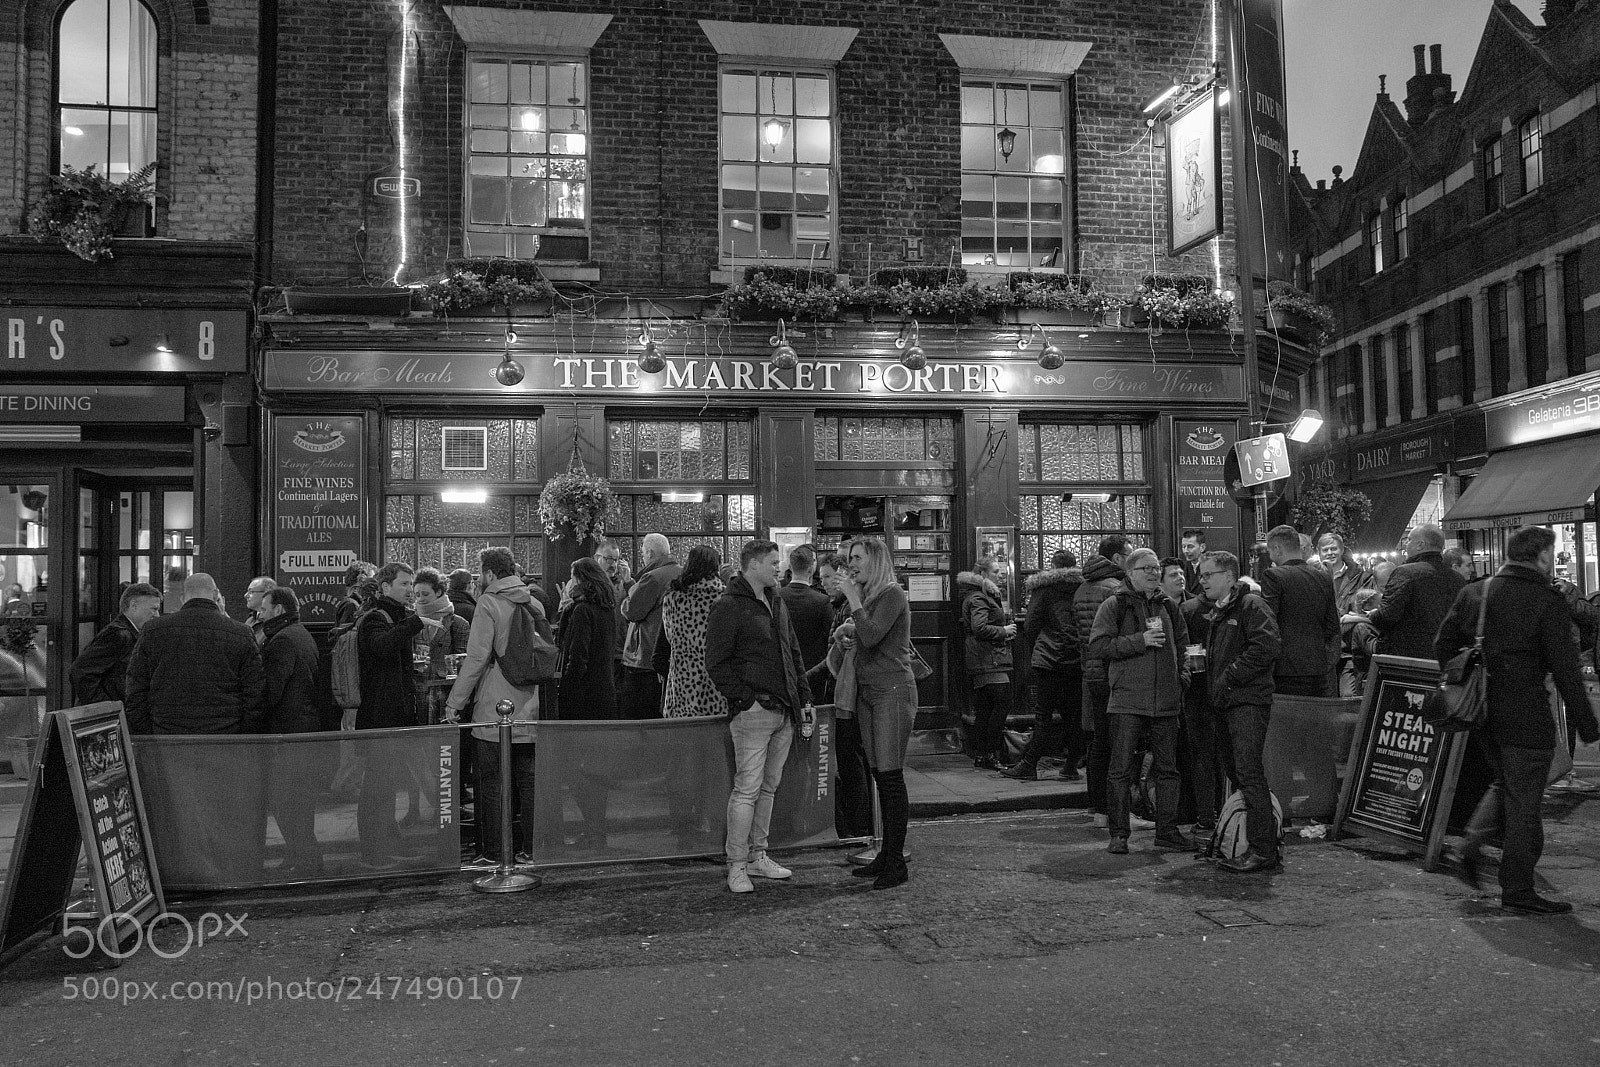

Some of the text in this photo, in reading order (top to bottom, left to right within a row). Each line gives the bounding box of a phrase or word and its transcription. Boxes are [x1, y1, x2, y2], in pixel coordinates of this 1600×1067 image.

[8, 316, 65, 360] R'S
[199, 321, 215, 360] 8
[307, 356, 452, 383] Bar Meals
[554, 357, 1008, 393] THE MARKET PORTER
[1092, 368, 1214, 393] Fine Wines
[0, 396, 91, 411] TE DINING
[1528, 402, 1571, 424] Gelateria
[307, 421, 332, 431] THE
[1195, 426, 1214, 435] THE
[1403, 438, 1429, 451] BOROUGH
[1179, 456, 1225, 466] BAR MEA
[1405, 450, 1426, 461] MARKET
[1309, 459, 1335, 480] YARD
[1357, 447, 1391, 471] DAIRY
[283, 477, 354, 489] FINE WINES
[278, 490, 359, 503] Continental Lagers
[1179, 486, 1229, 496] FUNCTION ROO
[1189, 499, 1225, 509] available for
[279, 515, 359, 529] TRADITIONAL
[1201, 512, 1214, 522] hire
[1492, 517, 1522, 527] YOGHURT
[1547, 511, 1574, 522] COFFEE
[1450, 521, 1471, 530] GELATO
[306, 532, 332, 542] ALES
[288, 554, 350, 567] FULL MENU
[299, 593, 341, 608] REEHOUS
[1377, 728, 1434, 754] NIGHT
[817, 723, 829, 801] MEANTIME.
[1408, 773, 1423, 785] £20
[439, 745, 452, 829] MEANTIME.
[104, 851, 126, 884] HERE
